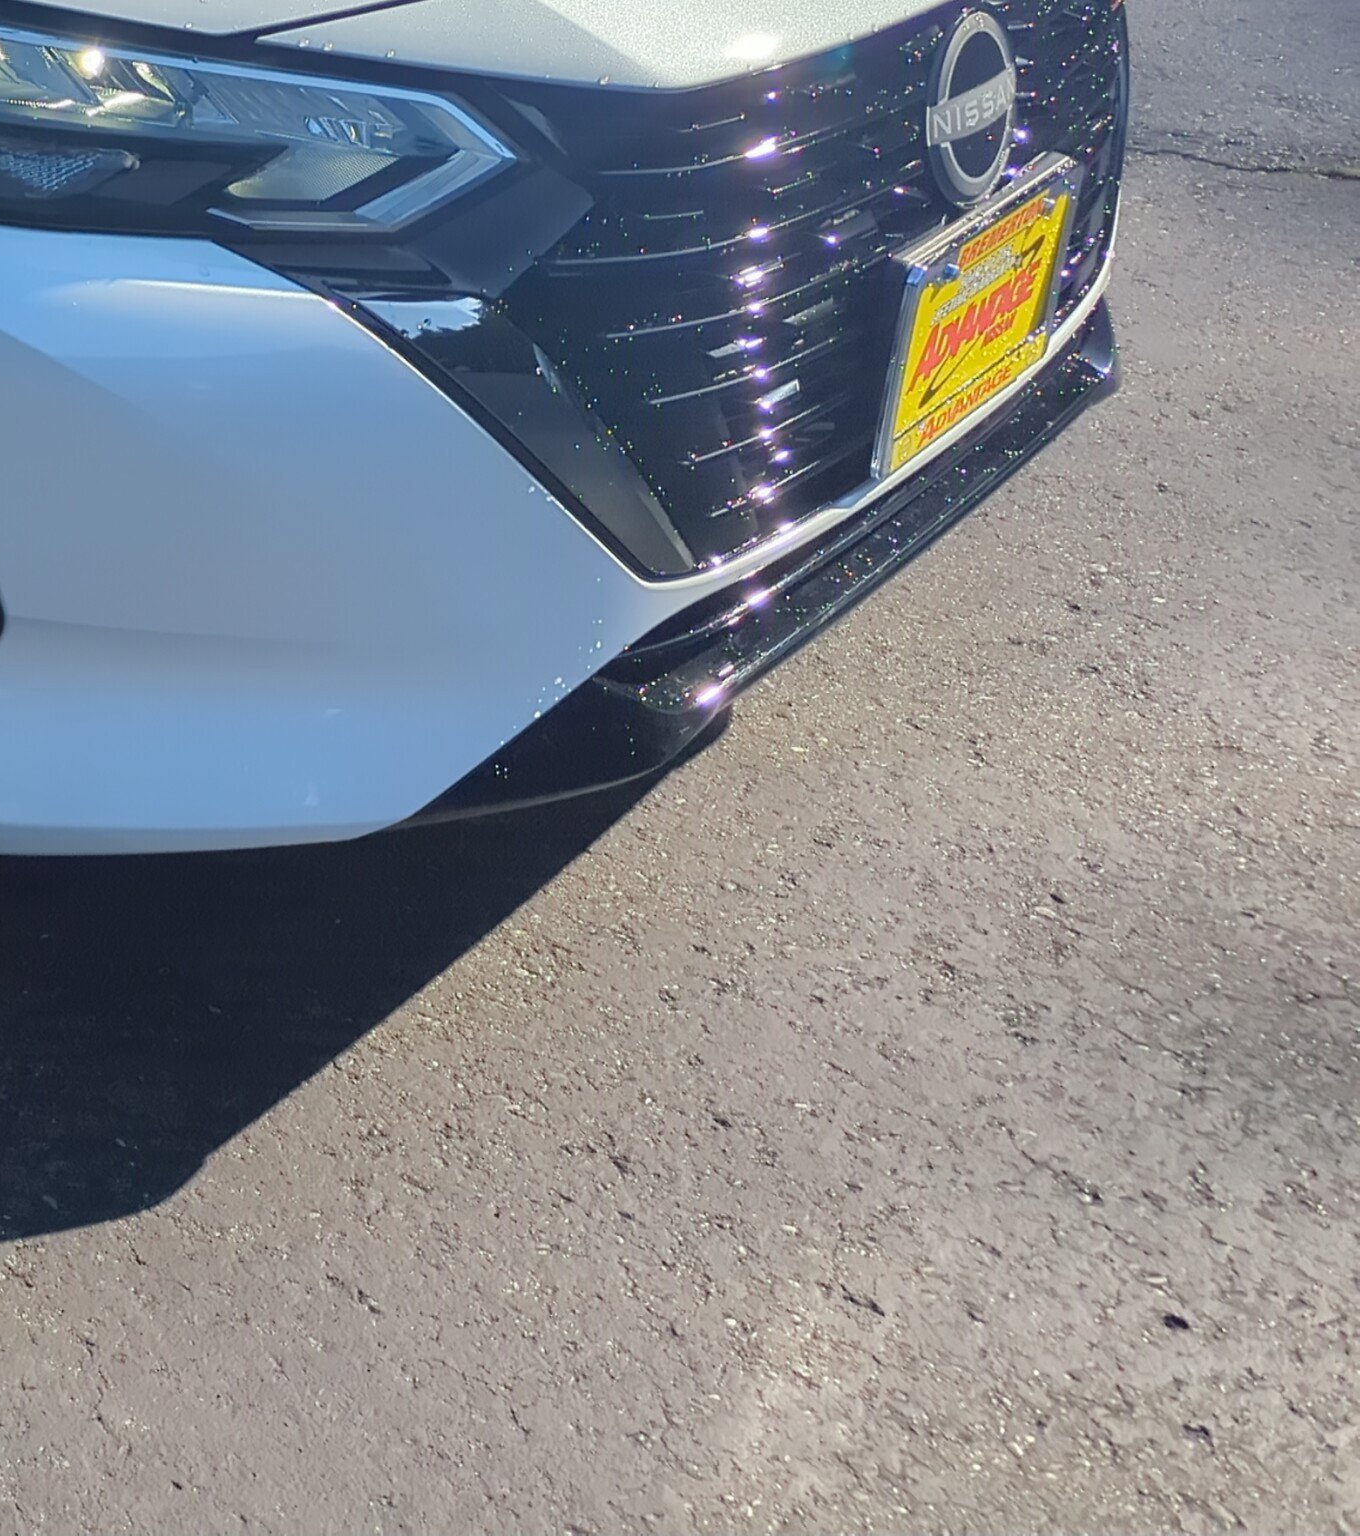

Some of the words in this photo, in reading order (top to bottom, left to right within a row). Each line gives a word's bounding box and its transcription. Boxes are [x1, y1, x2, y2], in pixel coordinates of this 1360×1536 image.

[932, 76, 1016, 139] NISSAN
[958, 196, 1046, 268] BREMERTON
[907, 258, 1043, 396] ADVANTAGE
[917, 363, 1013, 448] ADVANTAGE
